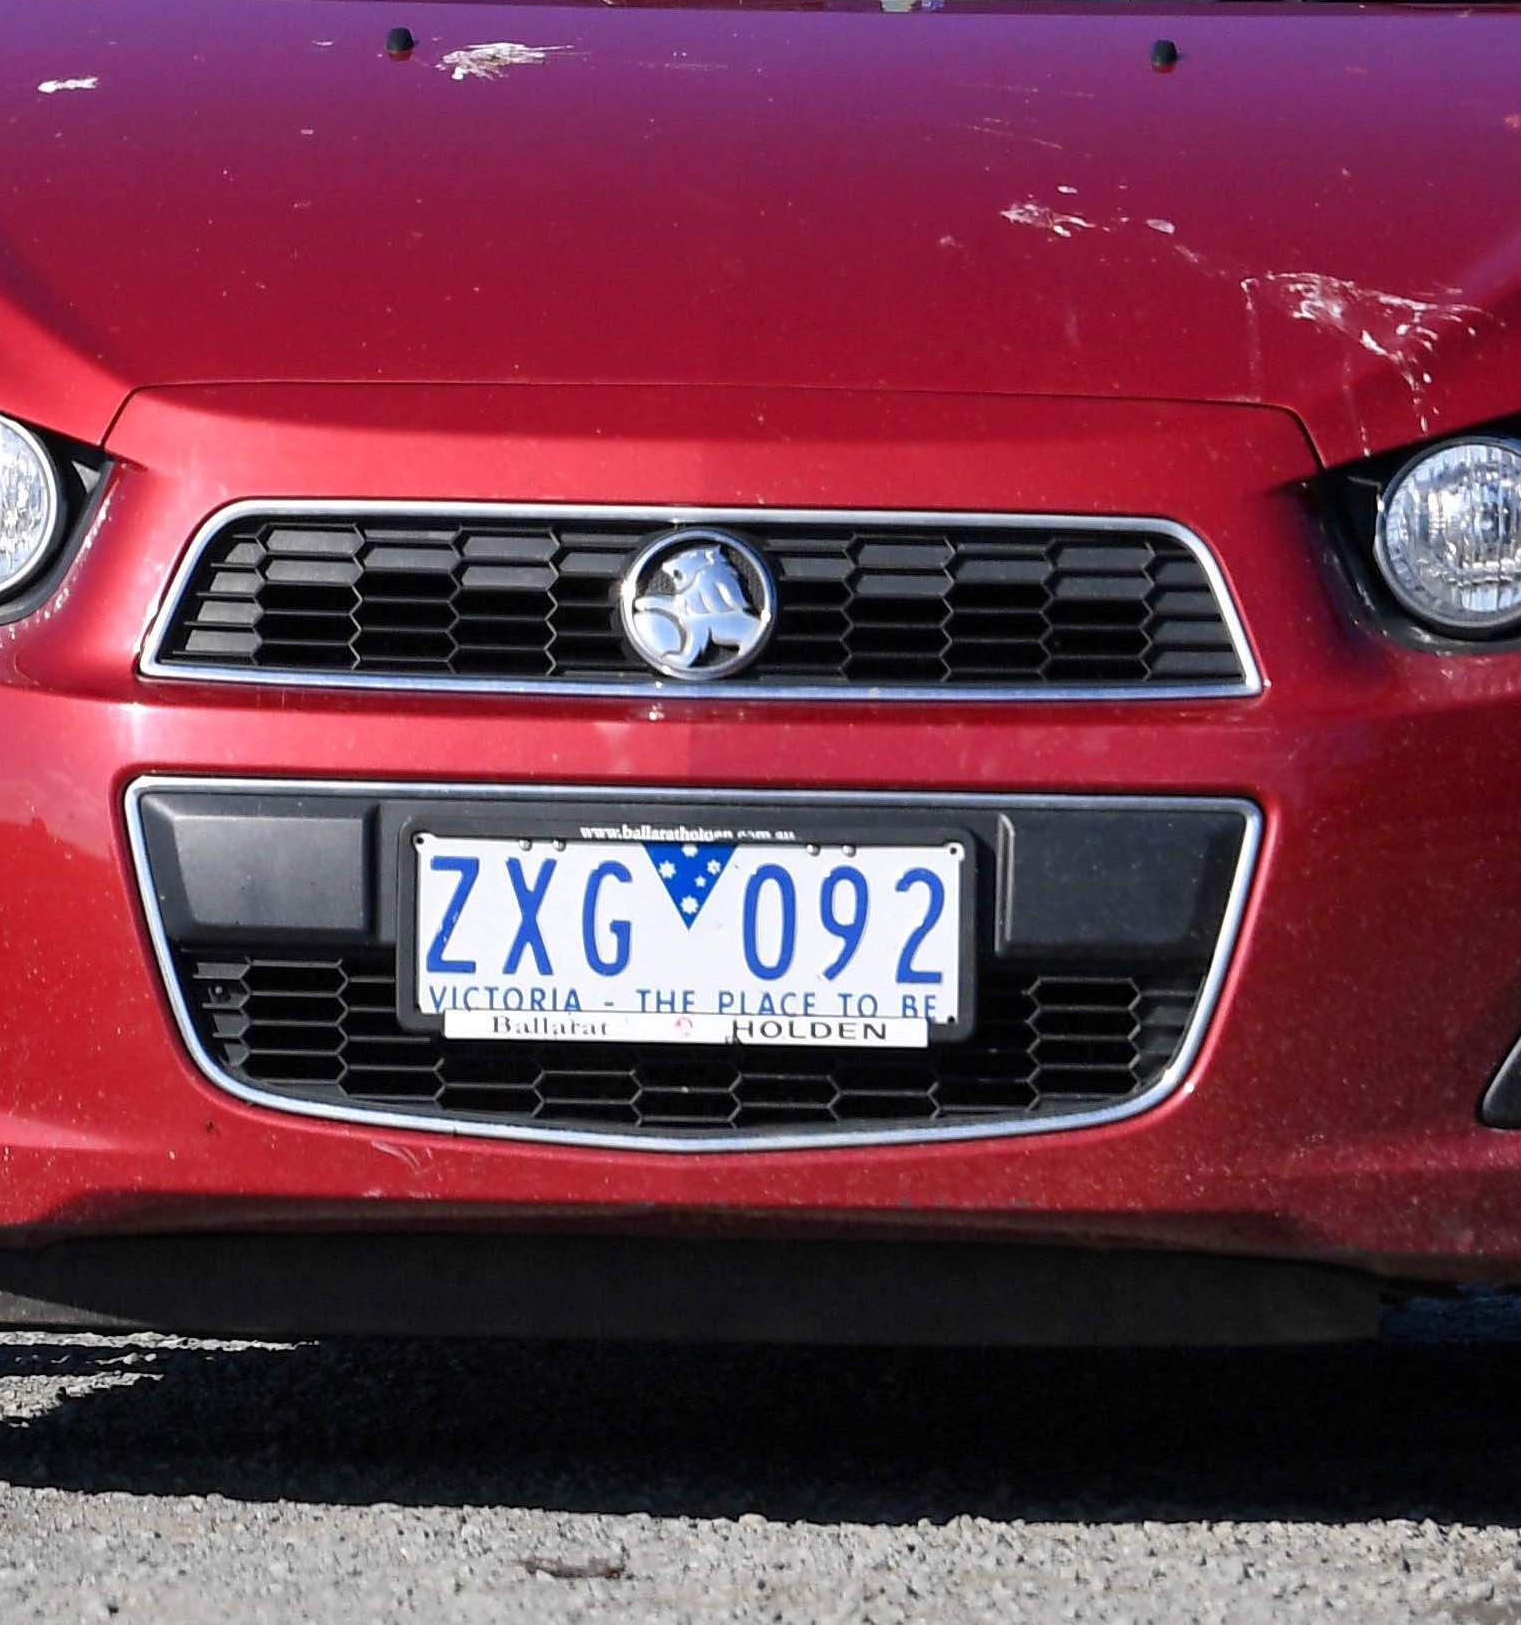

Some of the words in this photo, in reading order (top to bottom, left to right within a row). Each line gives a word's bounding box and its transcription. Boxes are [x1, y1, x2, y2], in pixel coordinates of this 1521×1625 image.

[425, 856, 633, 977] ZXG
[741, 862, 946, 985] 092
[428, 985, 583, 1013] VICTORIA
[636, 988, 696, 1014] THE
[718, 990, 816, 1017] PLACE
[837, 993, 878, 1018] TO
[901, 994, 937, 1021] BE
[492, 1015, 608, 1036] Ballarat
[733, 1020, 887, 1040] HOLDEN
